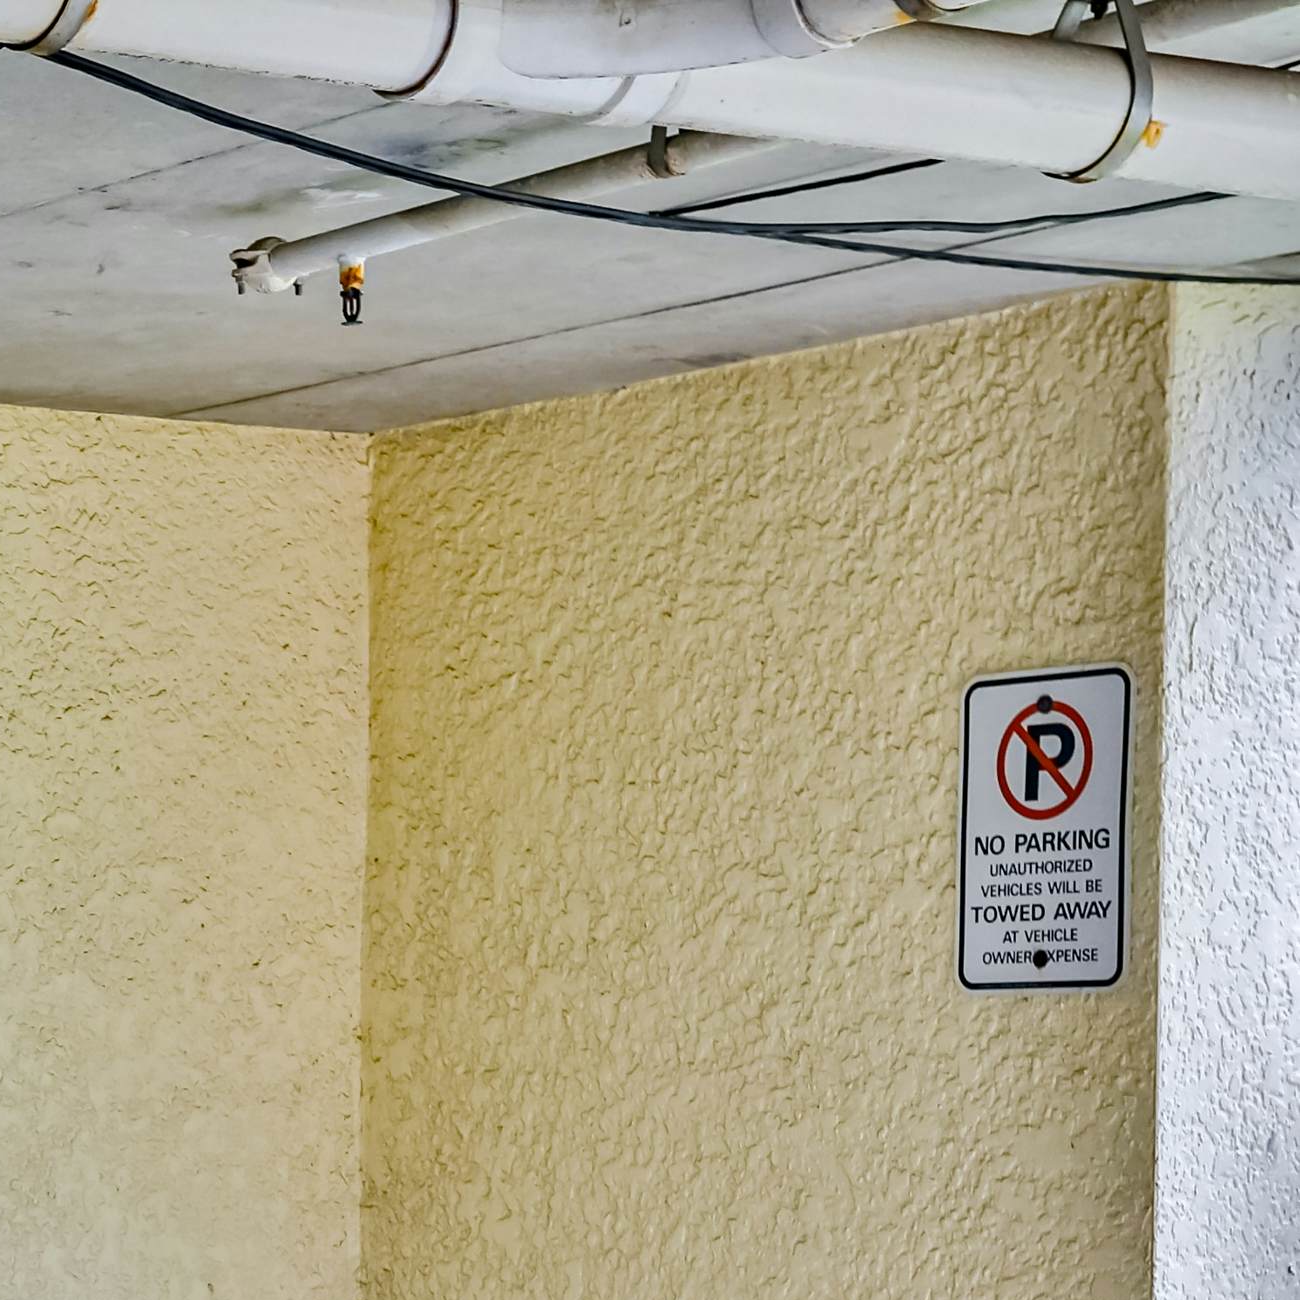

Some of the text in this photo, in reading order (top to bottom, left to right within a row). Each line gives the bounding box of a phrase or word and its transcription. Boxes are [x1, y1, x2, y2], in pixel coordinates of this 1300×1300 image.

[974, 828, 1110, 856] NO PARKING
[989, 858, 1093, 877] UNAUTHORIZED
[981, 879, 1103, 898] VEHICLES WILL BE
[971, 900, 1112, 924] TOWED AWAY
[1002, 928, 1078, 944] AT VEHICLE
[982, 948, 1099, 965] OWNER XPENSE
